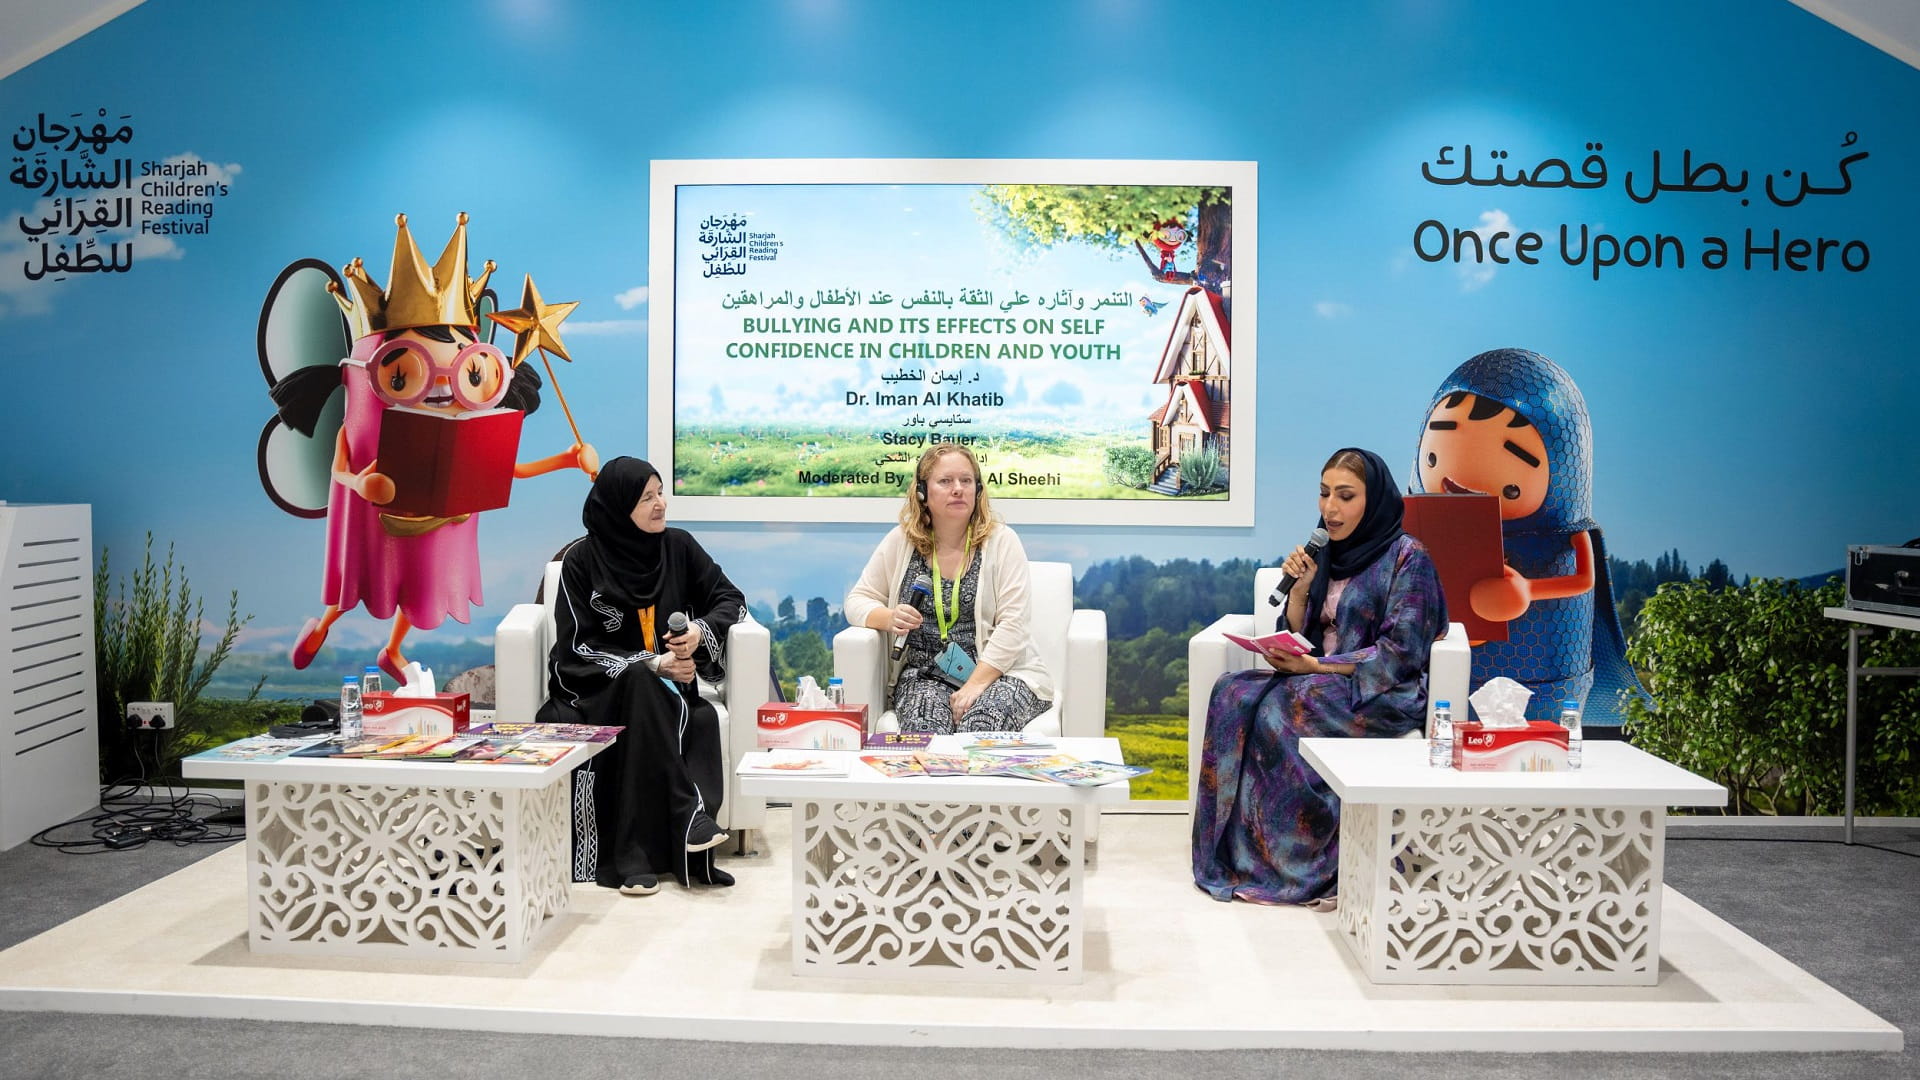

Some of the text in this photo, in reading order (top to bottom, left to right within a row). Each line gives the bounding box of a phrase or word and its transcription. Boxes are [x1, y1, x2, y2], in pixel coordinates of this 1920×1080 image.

[141, 161, 208, 180] Sharjah
[1421, 142, 1608, 190] قصتك
[1625, 149, 1749, 206] بطل
[141, 181, 228, 197] Children's
[142, 201, 213, 218] Reading
[142, 219, 209, 235] Festival
[749, 232, 776, 240] Sharjah
[749, 247, 778, 255] Reading
[1413, 219, 1870, 281] Once Upon a Hero
[722, 290, 804, 310] والمراهقين
[868, 290, 893, 306] عند
[901, 290, 953, 310] بالنفس
[959, 287, 993, 307] الثقة
[1090, 291, 1133, 310] التنمر
[743, 317, 1105, 335] BULLYING AND ITS EFFECTS ON SELF
[726, 343, 1121, 361] CONFIDENCE IN CHILDREN AND YOUTH
[881, 369, 980, 386] د. إيمان الخطيب
[846, 391, 1004, 407] Dr. Iman Al Khatib
[902, 414, 972, 427] ستايسي باور
[883, 433, 977, 448] Stacy Bauer
[799, 471, 1061, 487] Moderated By Al Sheehi
[762, 715, 776, 723] Leo
